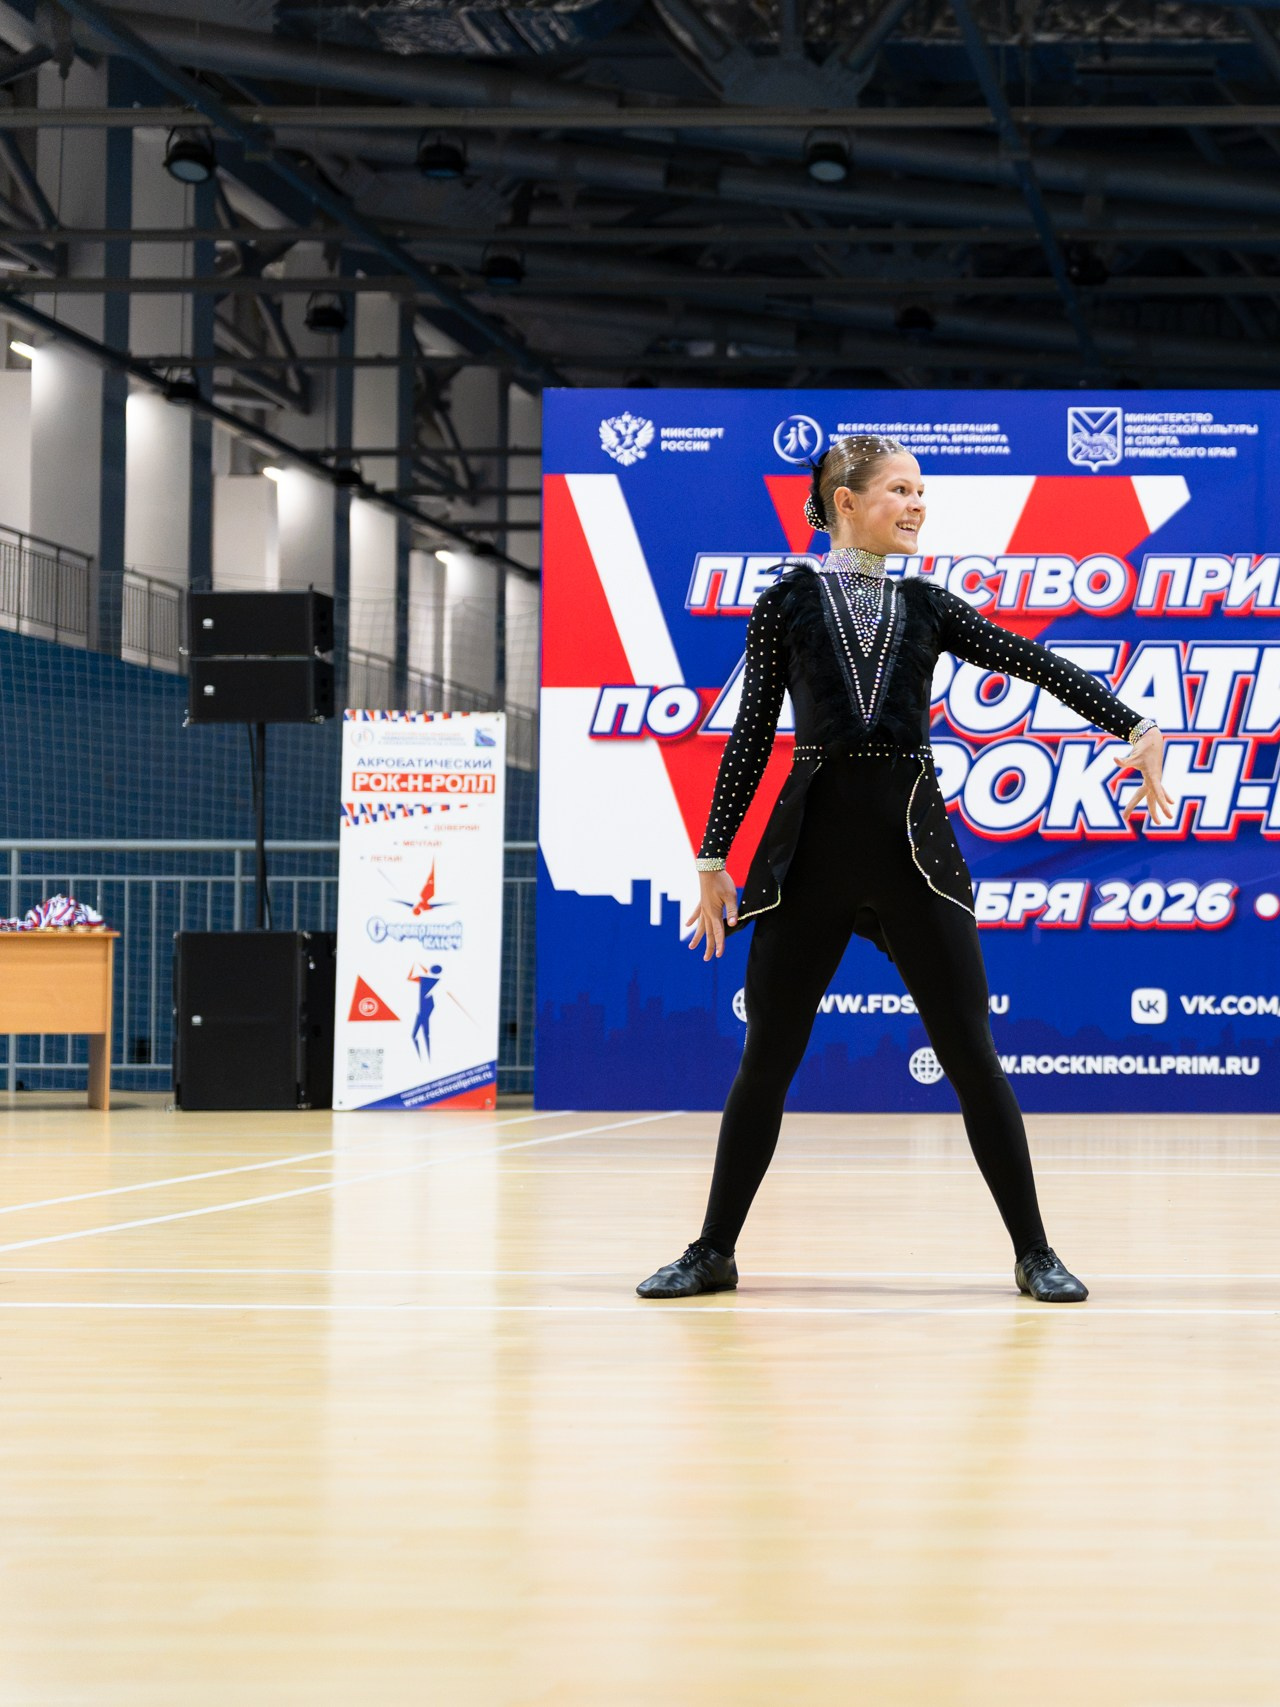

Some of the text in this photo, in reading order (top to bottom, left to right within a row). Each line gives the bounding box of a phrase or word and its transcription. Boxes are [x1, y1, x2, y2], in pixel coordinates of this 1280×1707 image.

[1125, 413, 1213, 424] МИНИСТЕРСТВО
[660, 427, 725, 440] МИНСПОРТ
[837, 422, 999, 433] ВСЕРОССИЙСКАЯ ФЕДЕРАЦИЯ
[1125, 424, 1259, 435] ФИЗИЧЕСКОЙ КУЛЬТУРЫ
[660, 440, 711, 452] РОССИИ
[1125, 436, 1179, 446] И СПОРТА
[1125, 447, 1237, 458] ПРИМОРСКОГО КРАЯ
[591, 685, 702, 737] ПО
[356, 756, 492, 769] АКРОБАТИЧЕСКИЙ
[354, 773, 493, 792] РОК-Н-РОЛЛ
[1090, 880, 1238, 924] 2026
[998, 1055, 1260, 1076] W.ROCKNROLLPRIM.RU
